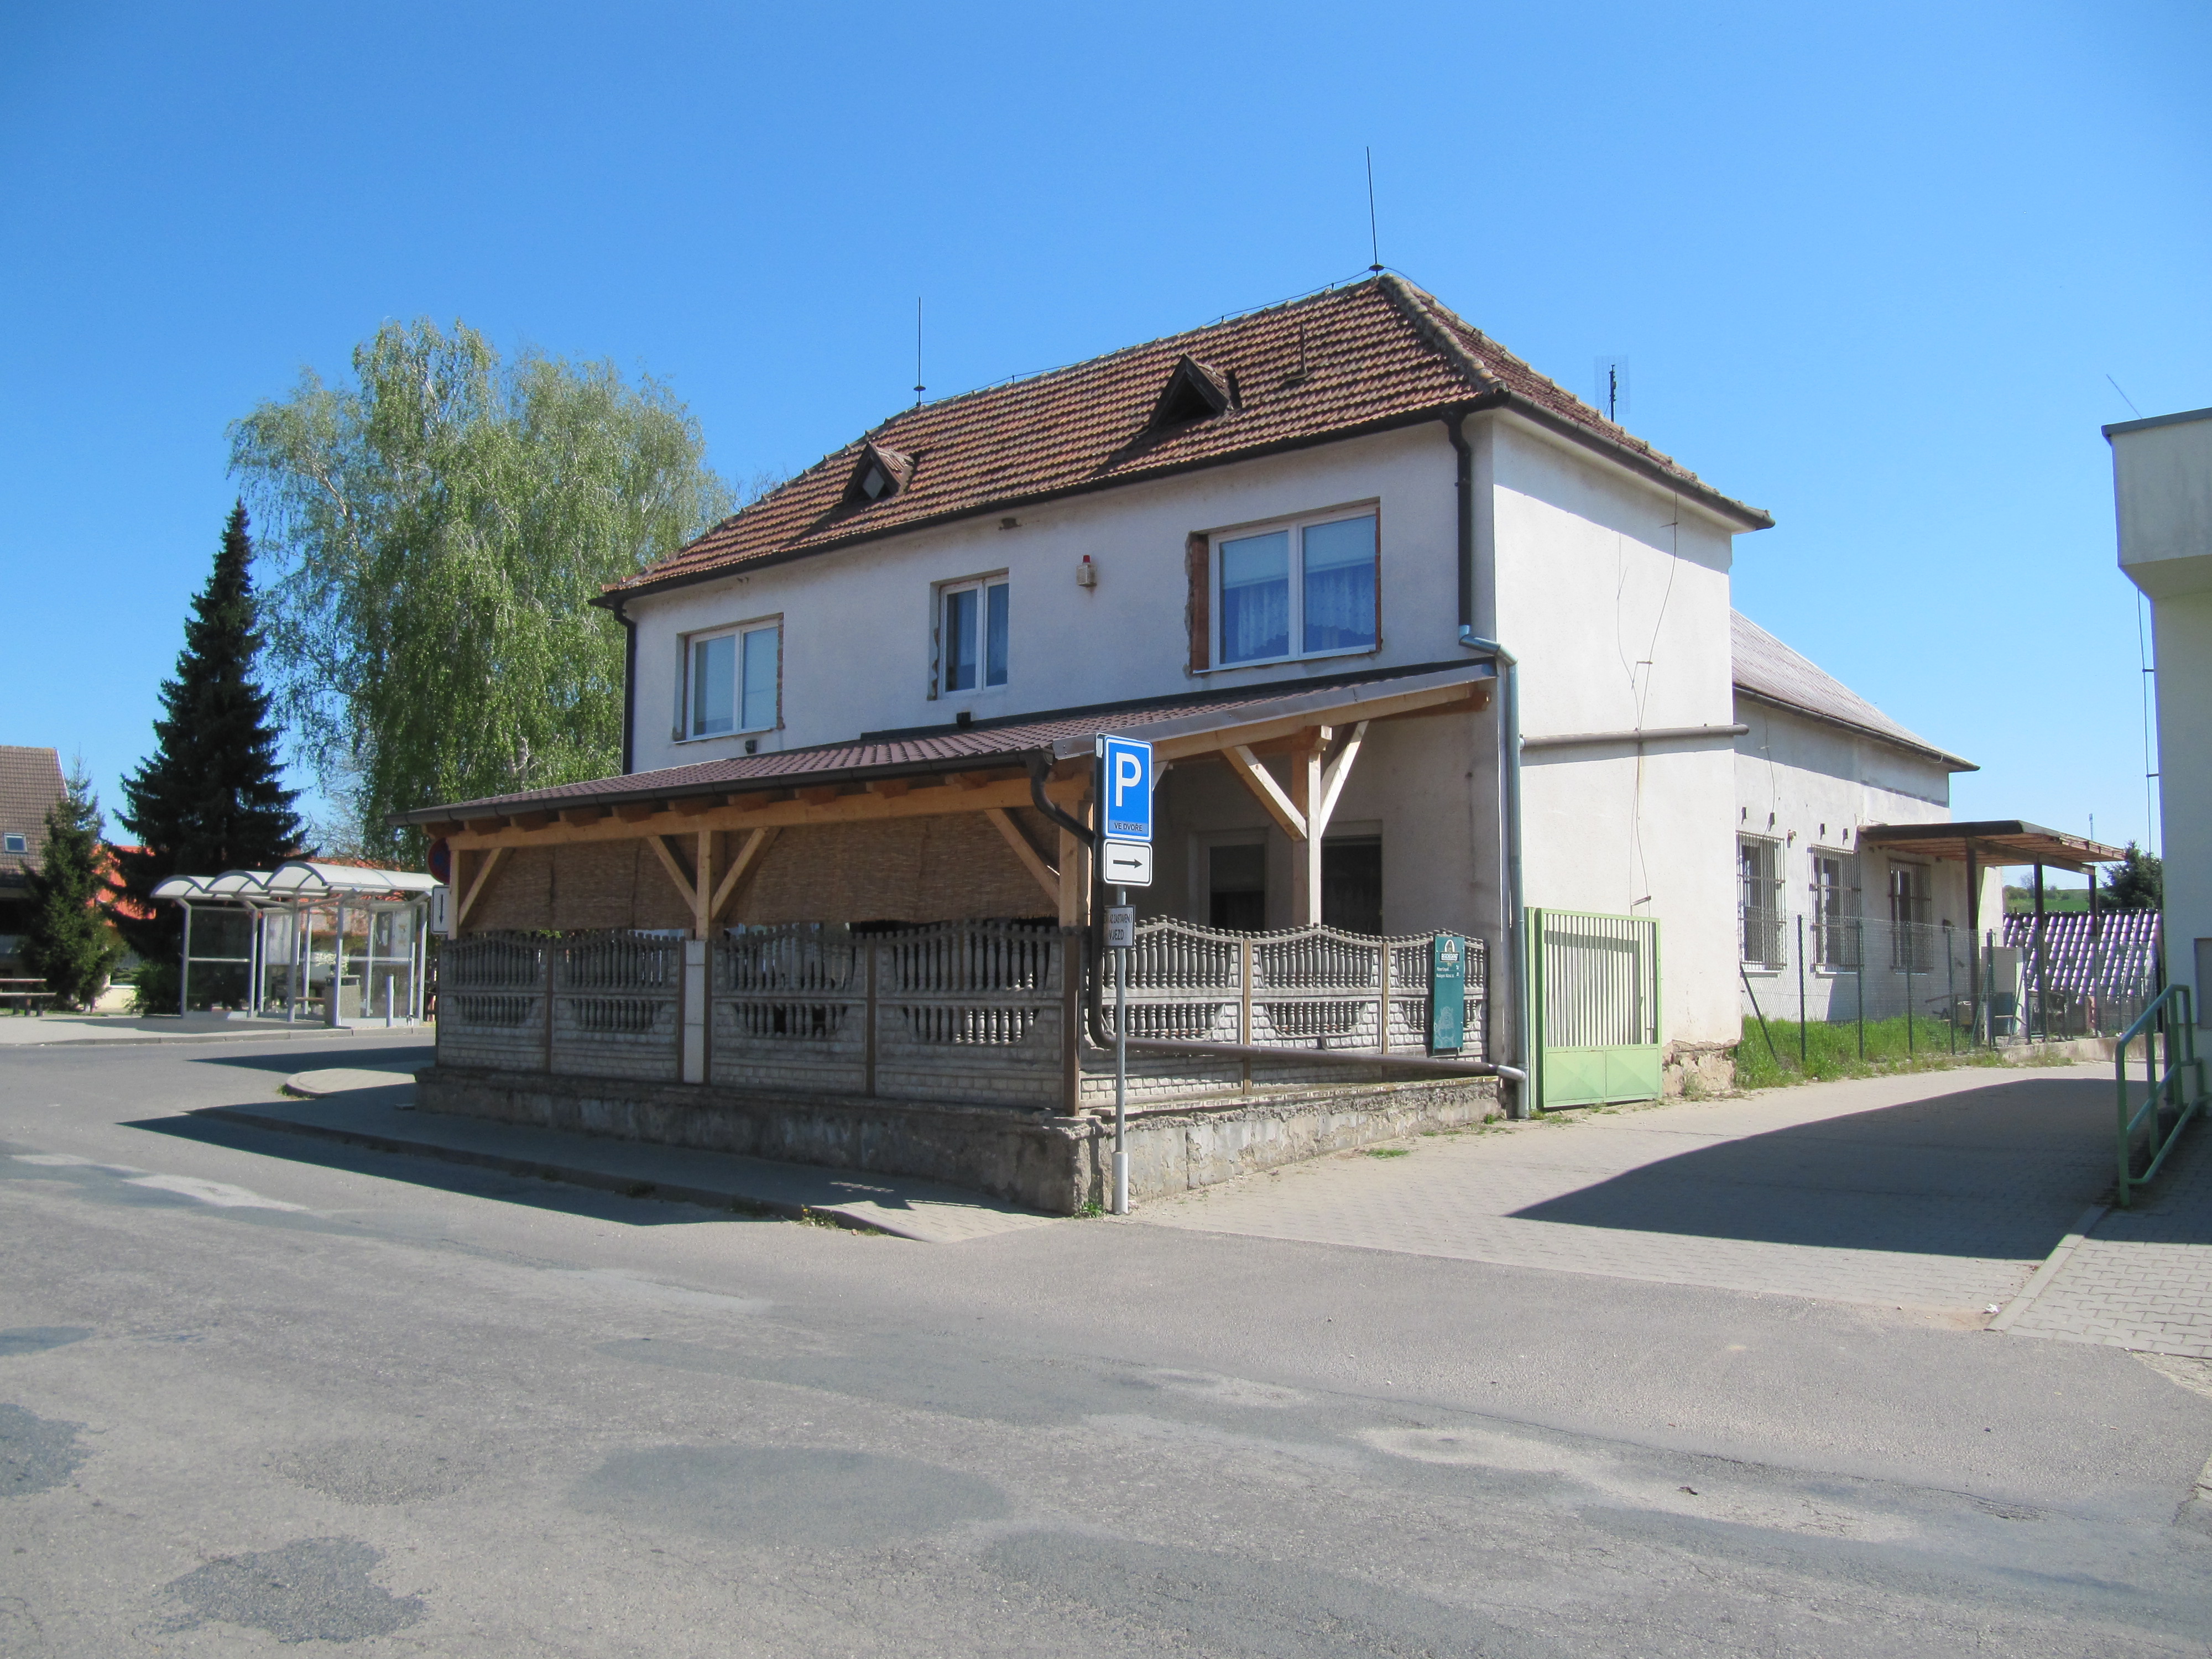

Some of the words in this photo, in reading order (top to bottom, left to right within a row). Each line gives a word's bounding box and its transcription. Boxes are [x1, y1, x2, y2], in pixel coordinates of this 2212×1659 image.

[1116, 752, 1141, 807] P
[1123, 823, 1142, 832] DVOŘE
[1109, 930, 1124, 940] VJEZD
